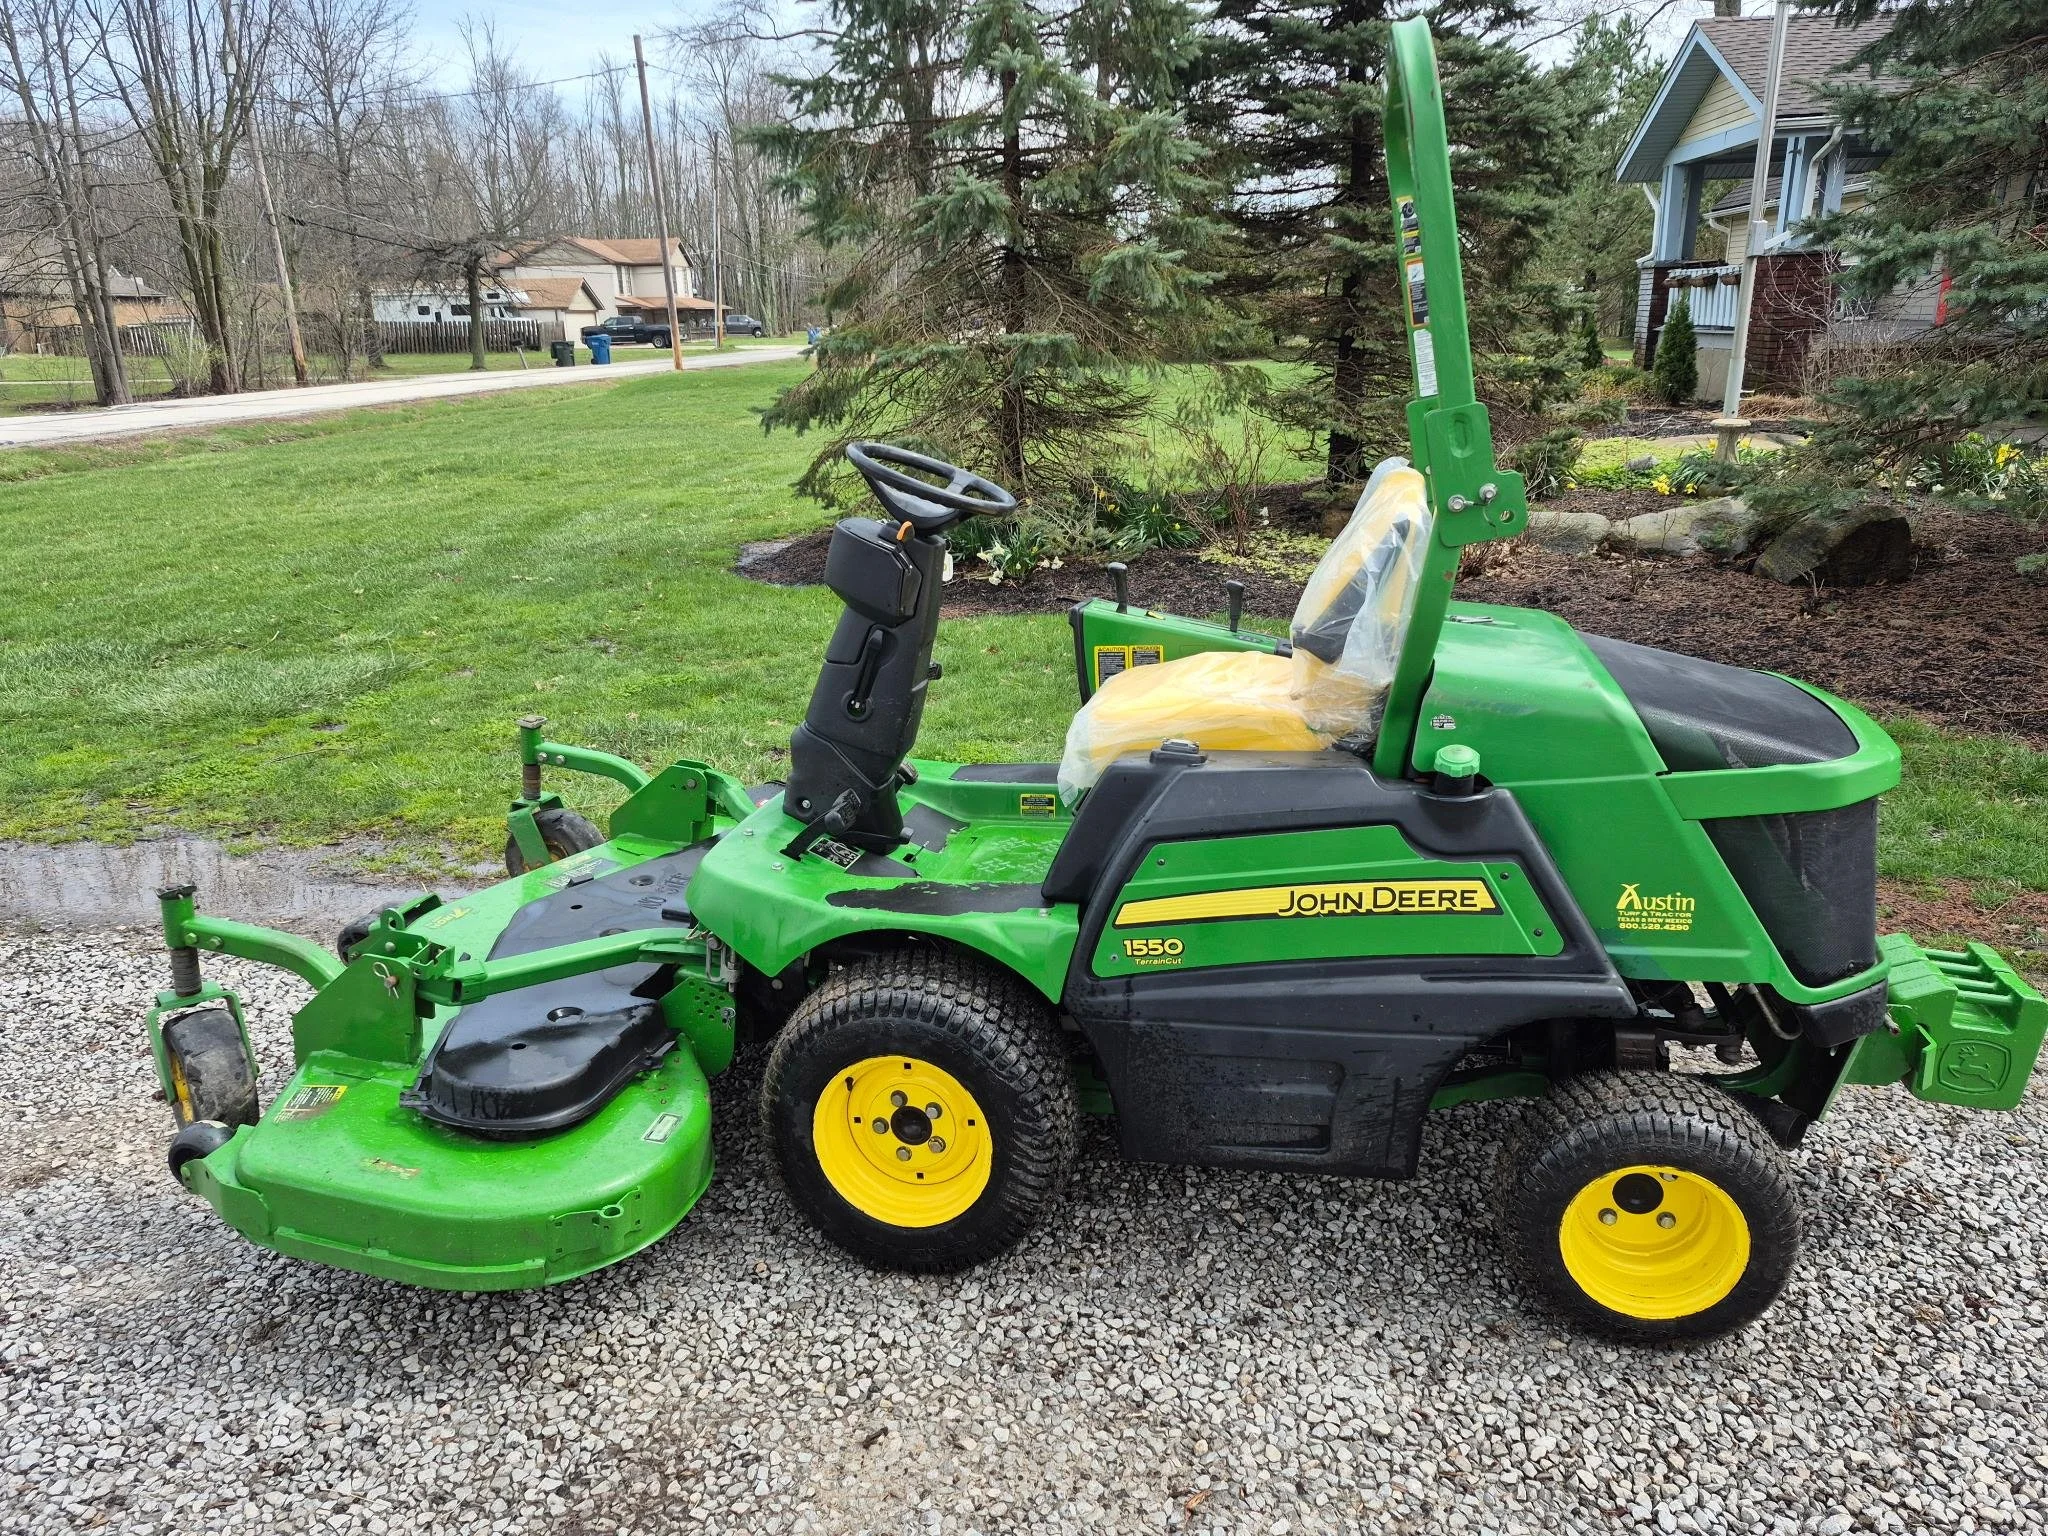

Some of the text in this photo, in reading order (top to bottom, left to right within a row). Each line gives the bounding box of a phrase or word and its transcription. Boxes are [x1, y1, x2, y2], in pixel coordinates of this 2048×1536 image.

[1278, 887, 1478, 912] JOHN DEERE
[1616, 883, 1695, 911] Austin
[1123, 938, 1184, 956] 1550
[1134, 957, 1182, 965] TerrainCut
